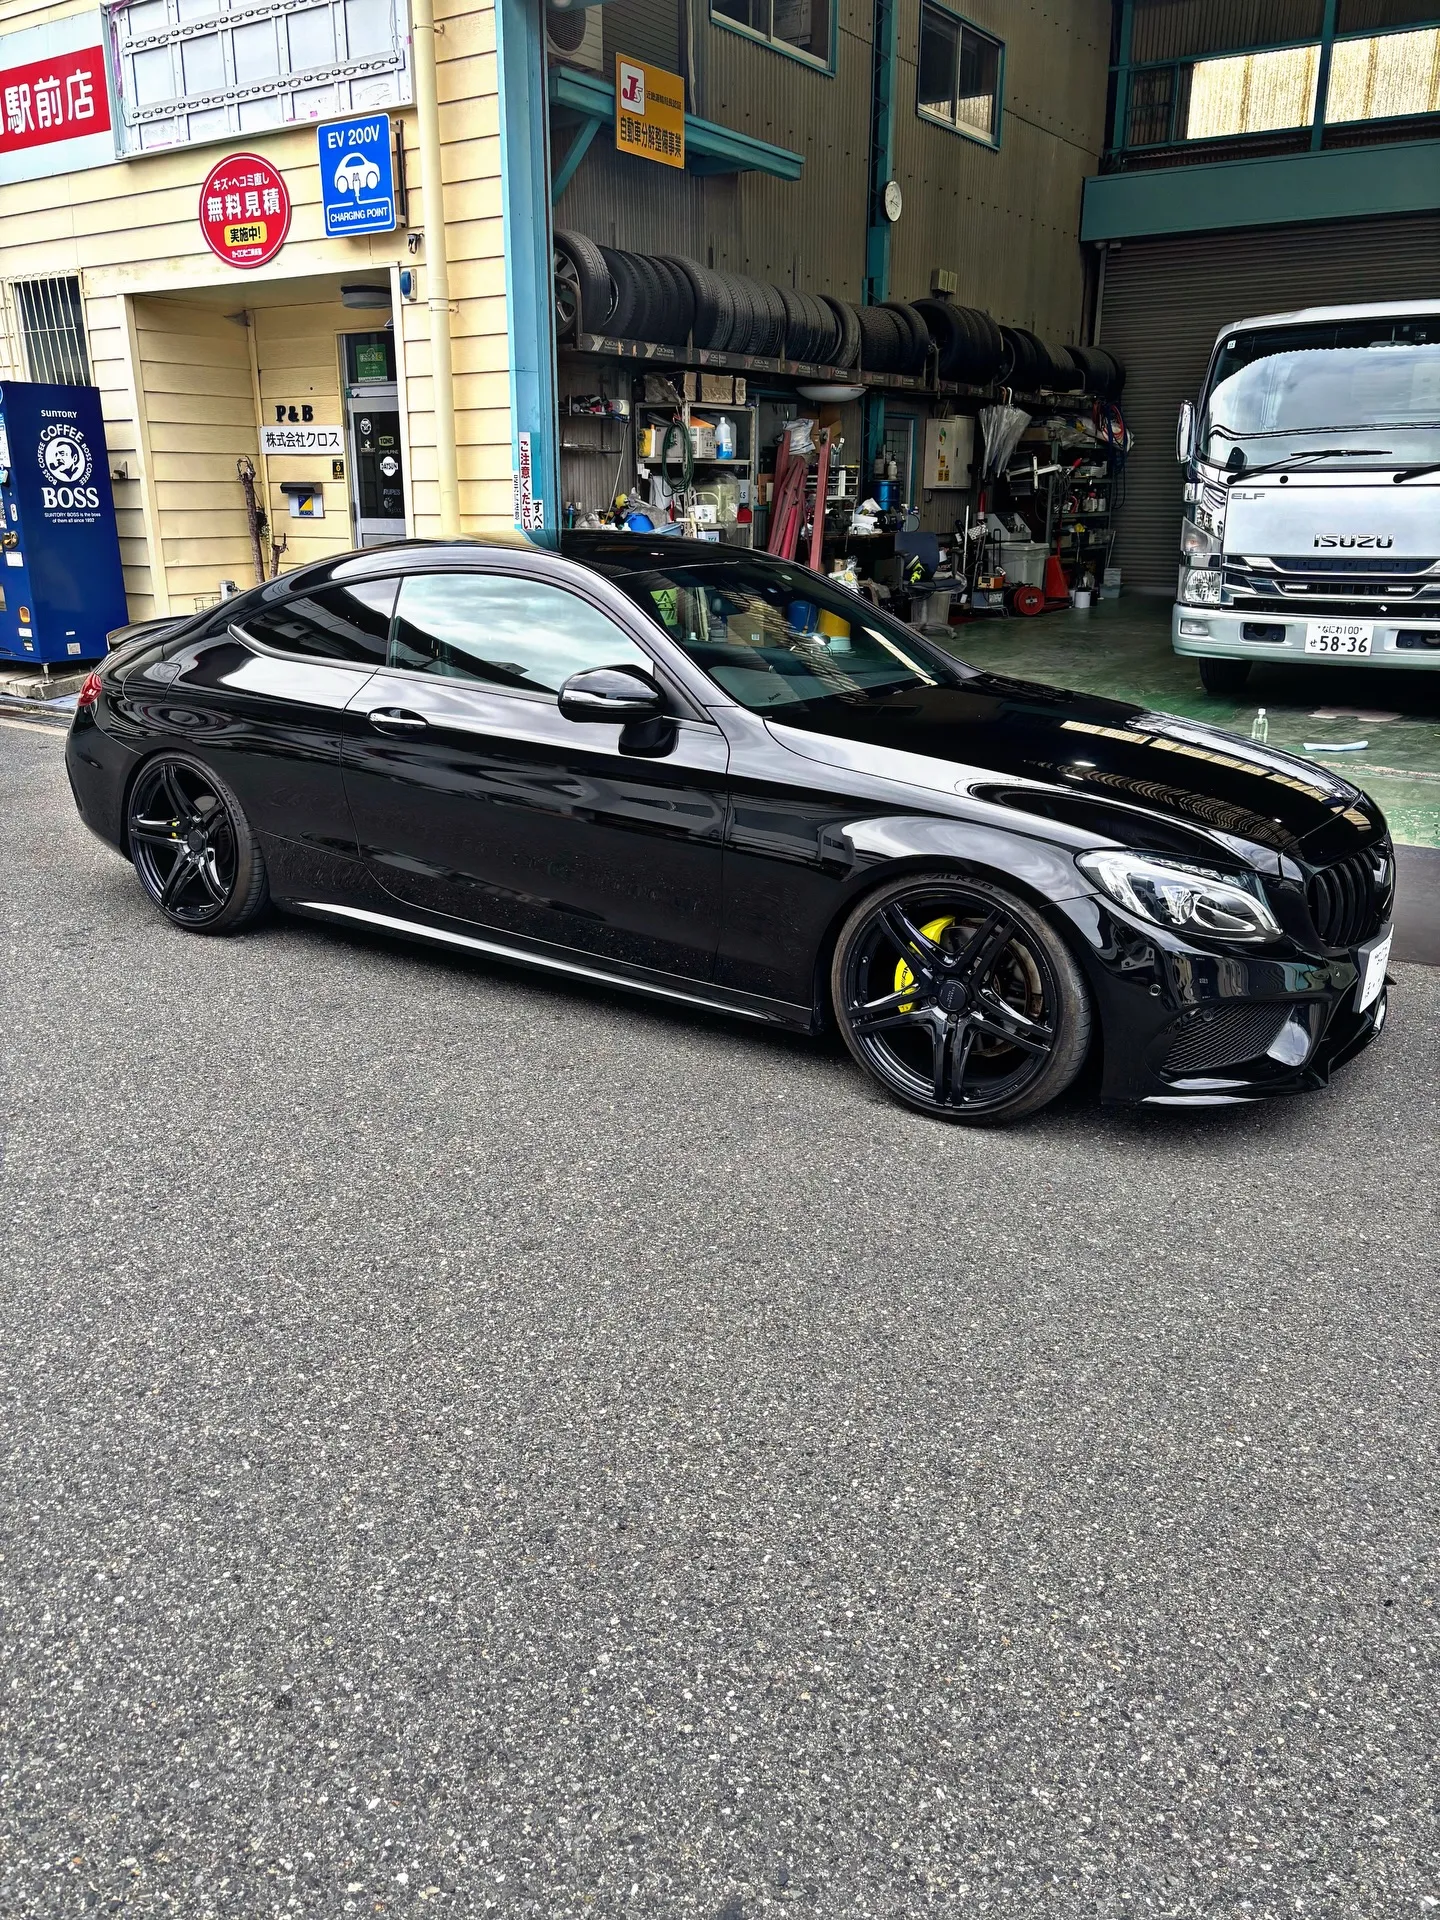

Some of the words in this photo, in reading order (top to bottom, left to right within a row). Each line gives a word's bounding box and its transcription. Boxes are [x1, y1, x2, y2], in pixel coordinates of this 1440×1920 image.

[0, 68, 94, 135] 駅前店
[328, 131, 344, 149] EV
[348, 124, 380, 146] 200V
[620, 115, 682, 158] 自動車分解整備事業
[213, 172, 270, 191] キズ・ヘコミ直し
[207, 188, 280, 222] 無料見積
[330, 210, 366, 222] CHARGING
[366, 206, 388, 218] POINT
[41, 409, 78, 419] SUNTORY
[40, 423, 84, 443] COFFEE
[266, 431, 340, 448] 株式会社クロス
[37, 441, 46, 469] COFFEE
[81, 443, 92, 461] BOSS
[42, 469, 58, 485] BOSS
[79, 463, 93, 485] COFFEE
[520, 440, 532, 530] ご注意ください
[41, 487, 100, 509] BOSS
[1231, 492, 1266, 500] ELF
[1313, 533, 1395, 549] ISUZU
[1310, 639, 1317, 648] せ
[1319, 635, 1368, 653] 58-36
[919, 873, 993, 890] FALKEN
